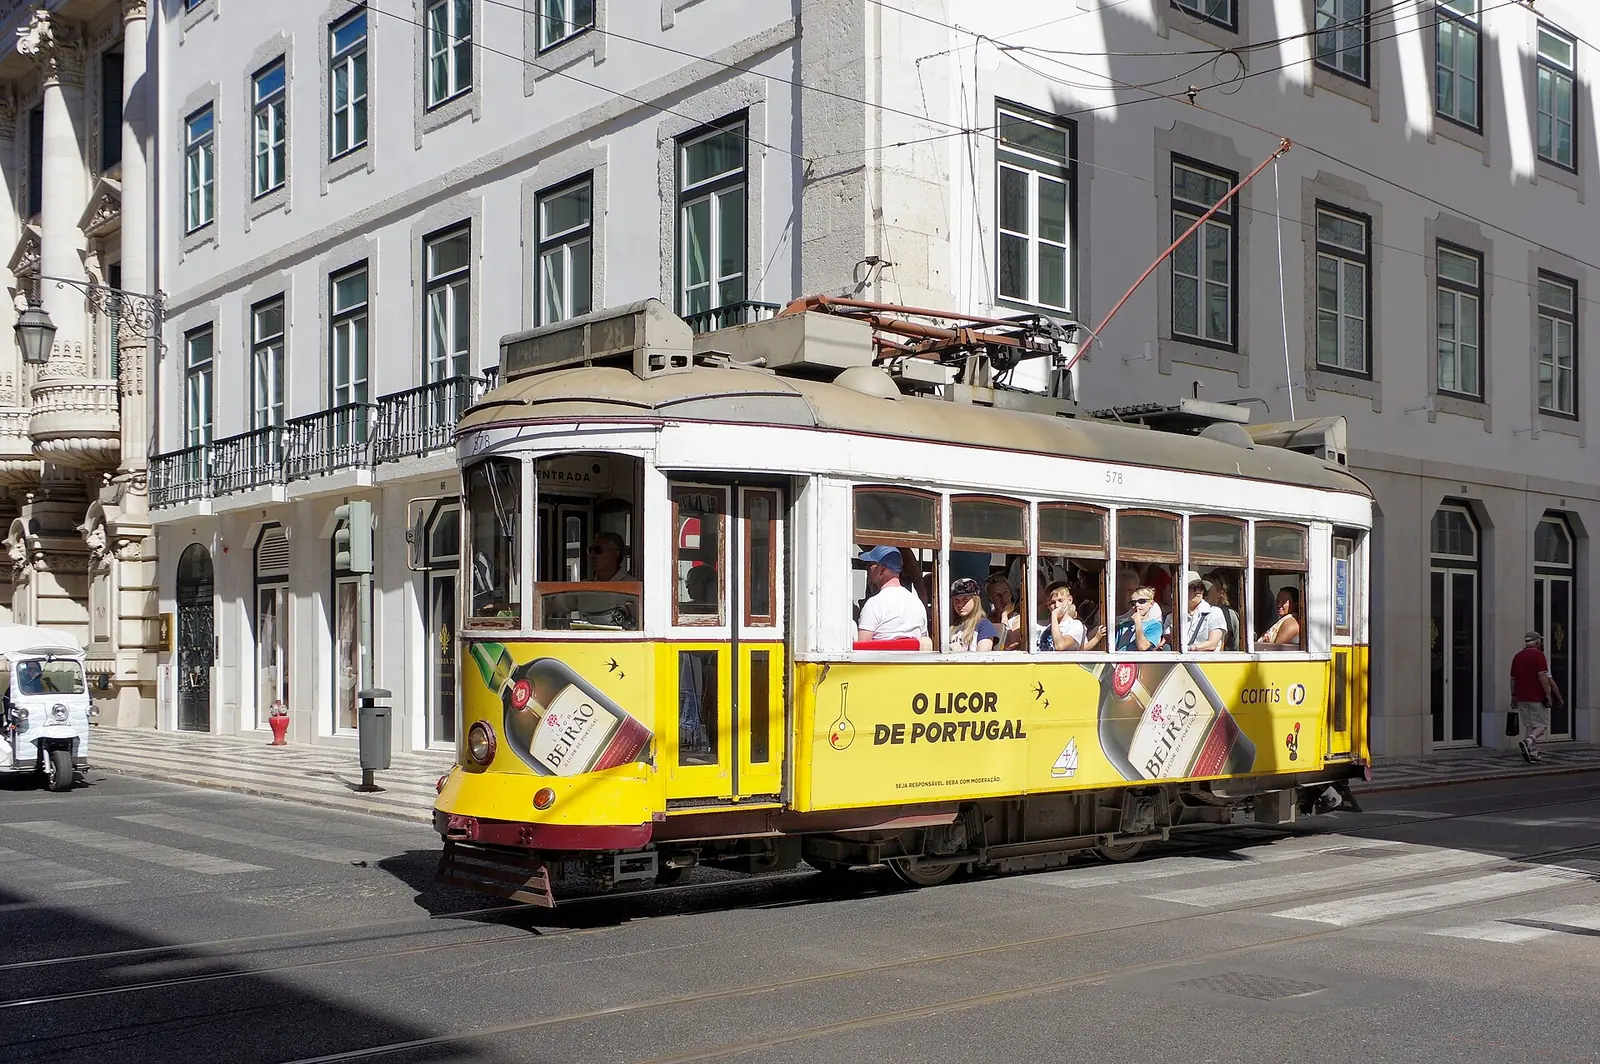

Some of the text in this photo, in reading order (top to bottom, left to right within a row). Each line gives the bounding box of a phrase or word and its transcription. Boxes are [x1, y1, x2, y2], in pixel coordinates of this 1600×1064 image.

[536, 469, 591, 482] ENTRADA
[1105, 470, 1123, 485] 578
[912, 691, 998, 715] O LICOR
[1241, 682, 1280, 704] carris
[546, 703, 594, 768] BEIRÃO
[873, 719, 1027, 746] DE PORTUGAL
[1145, 689, 1197, 779] BEIRÃO
